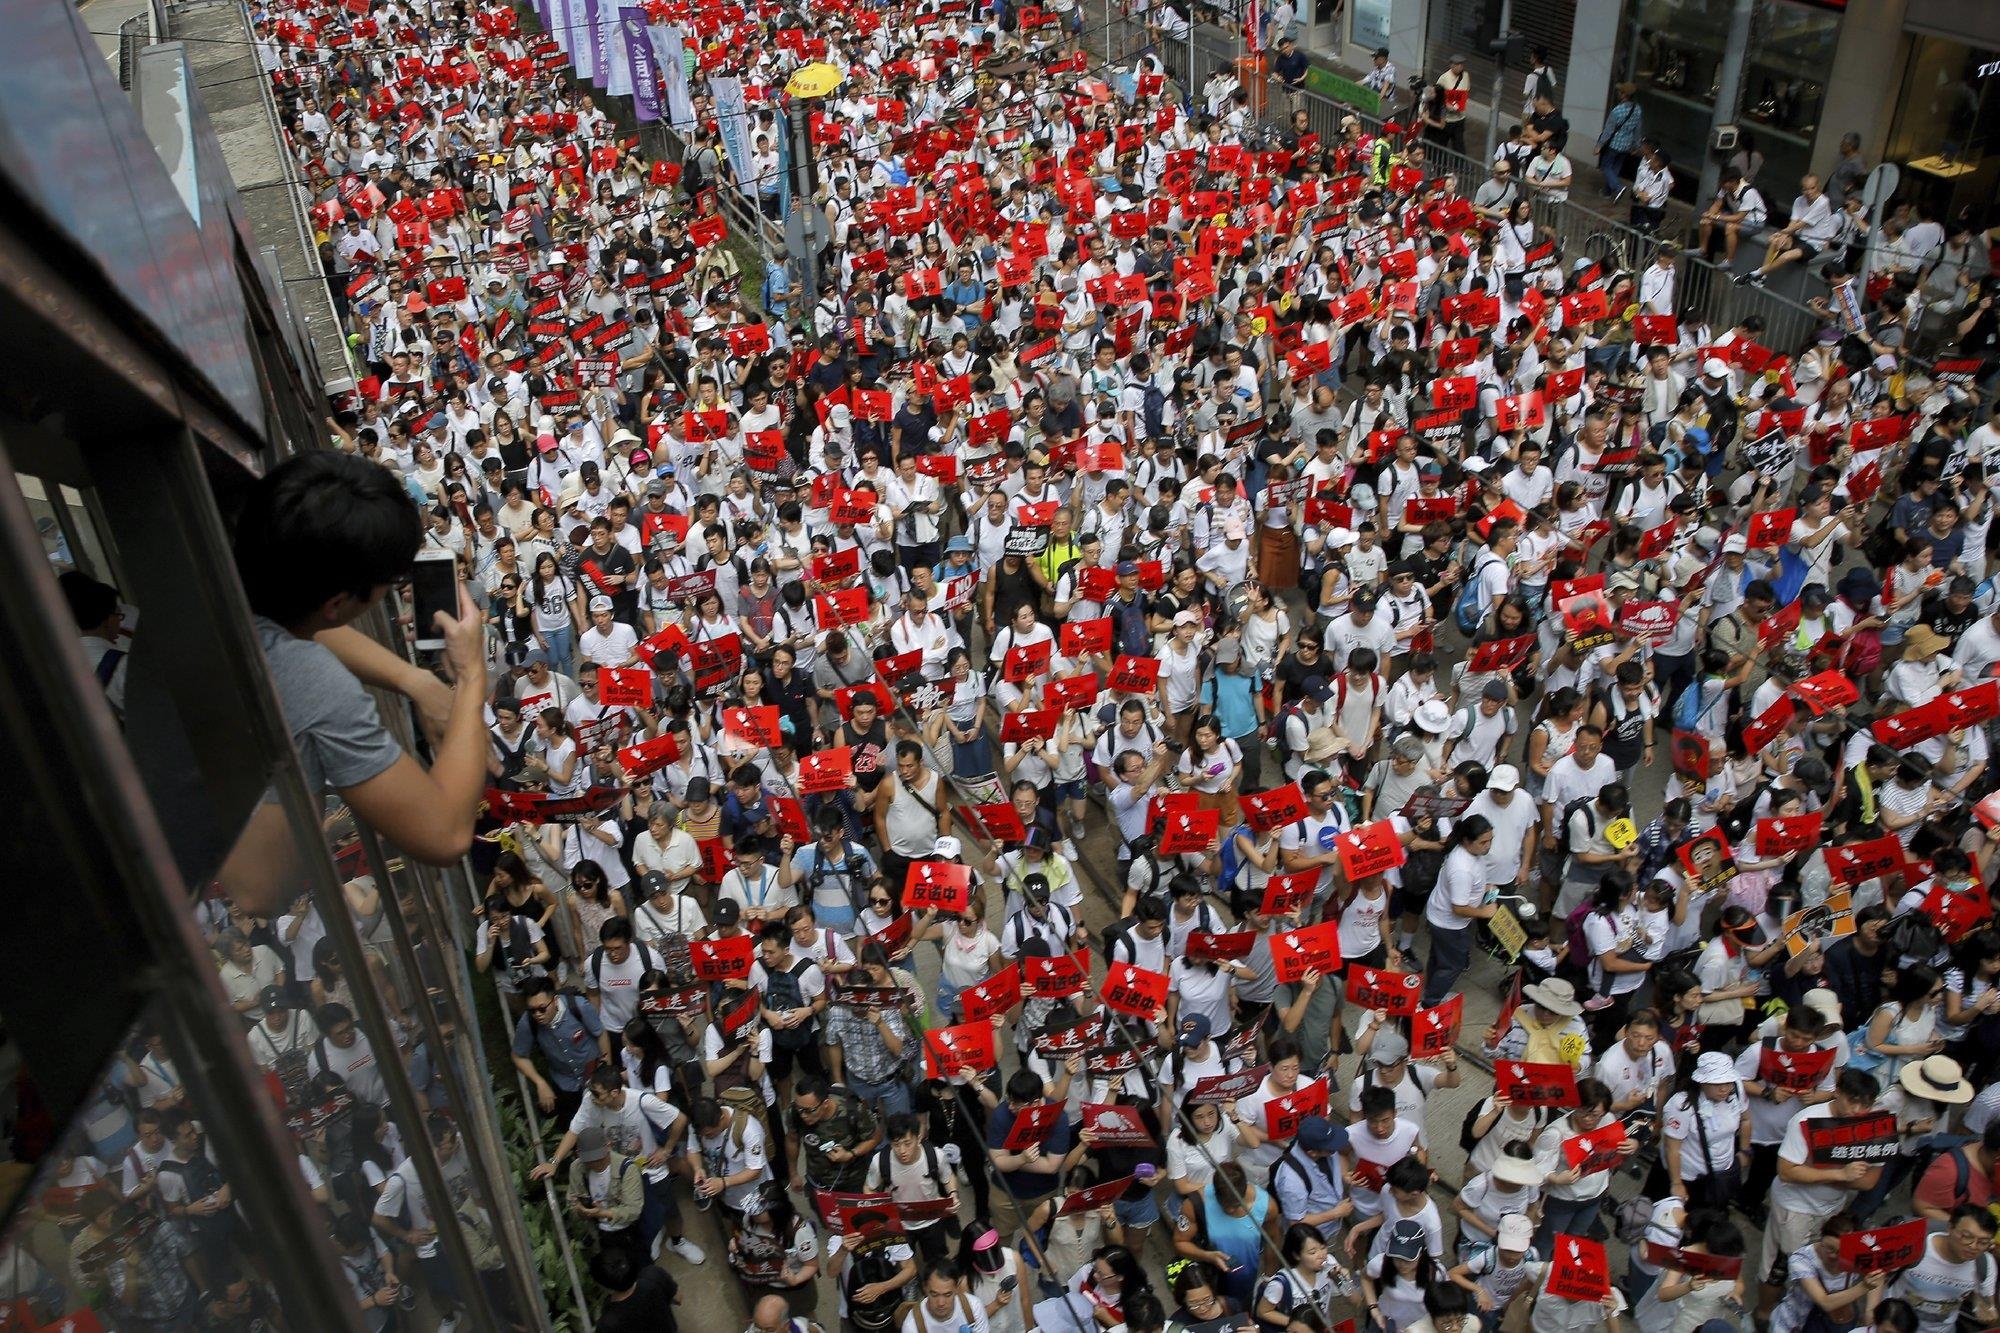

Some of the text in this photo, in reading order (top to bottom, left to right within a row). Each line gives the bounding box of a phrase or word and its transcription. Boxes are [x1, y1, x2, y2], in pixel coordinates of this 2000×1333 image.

[1505, 407, 1537, 426] 反中
[854, 752, 877, 773] 23
[1254, 804, 1297, 826] 反送中
[1350, 852, 1365, 866] No
[1842, 856, 1895, 880] 反送中
[913, 883, 959, 902] 反送中
[701, 956, 745, 975] 反送中
[1284, 950, 1331, 970] No China
[1109, 985, 1156, 1010] 反送中
[1357, 987, 1407, 1008] 反送中
[1035, 1022, 1102, 1049] 反送中
[952, 1048, 985, 1062] China
[1562, 1265, 1574, 1282] No
